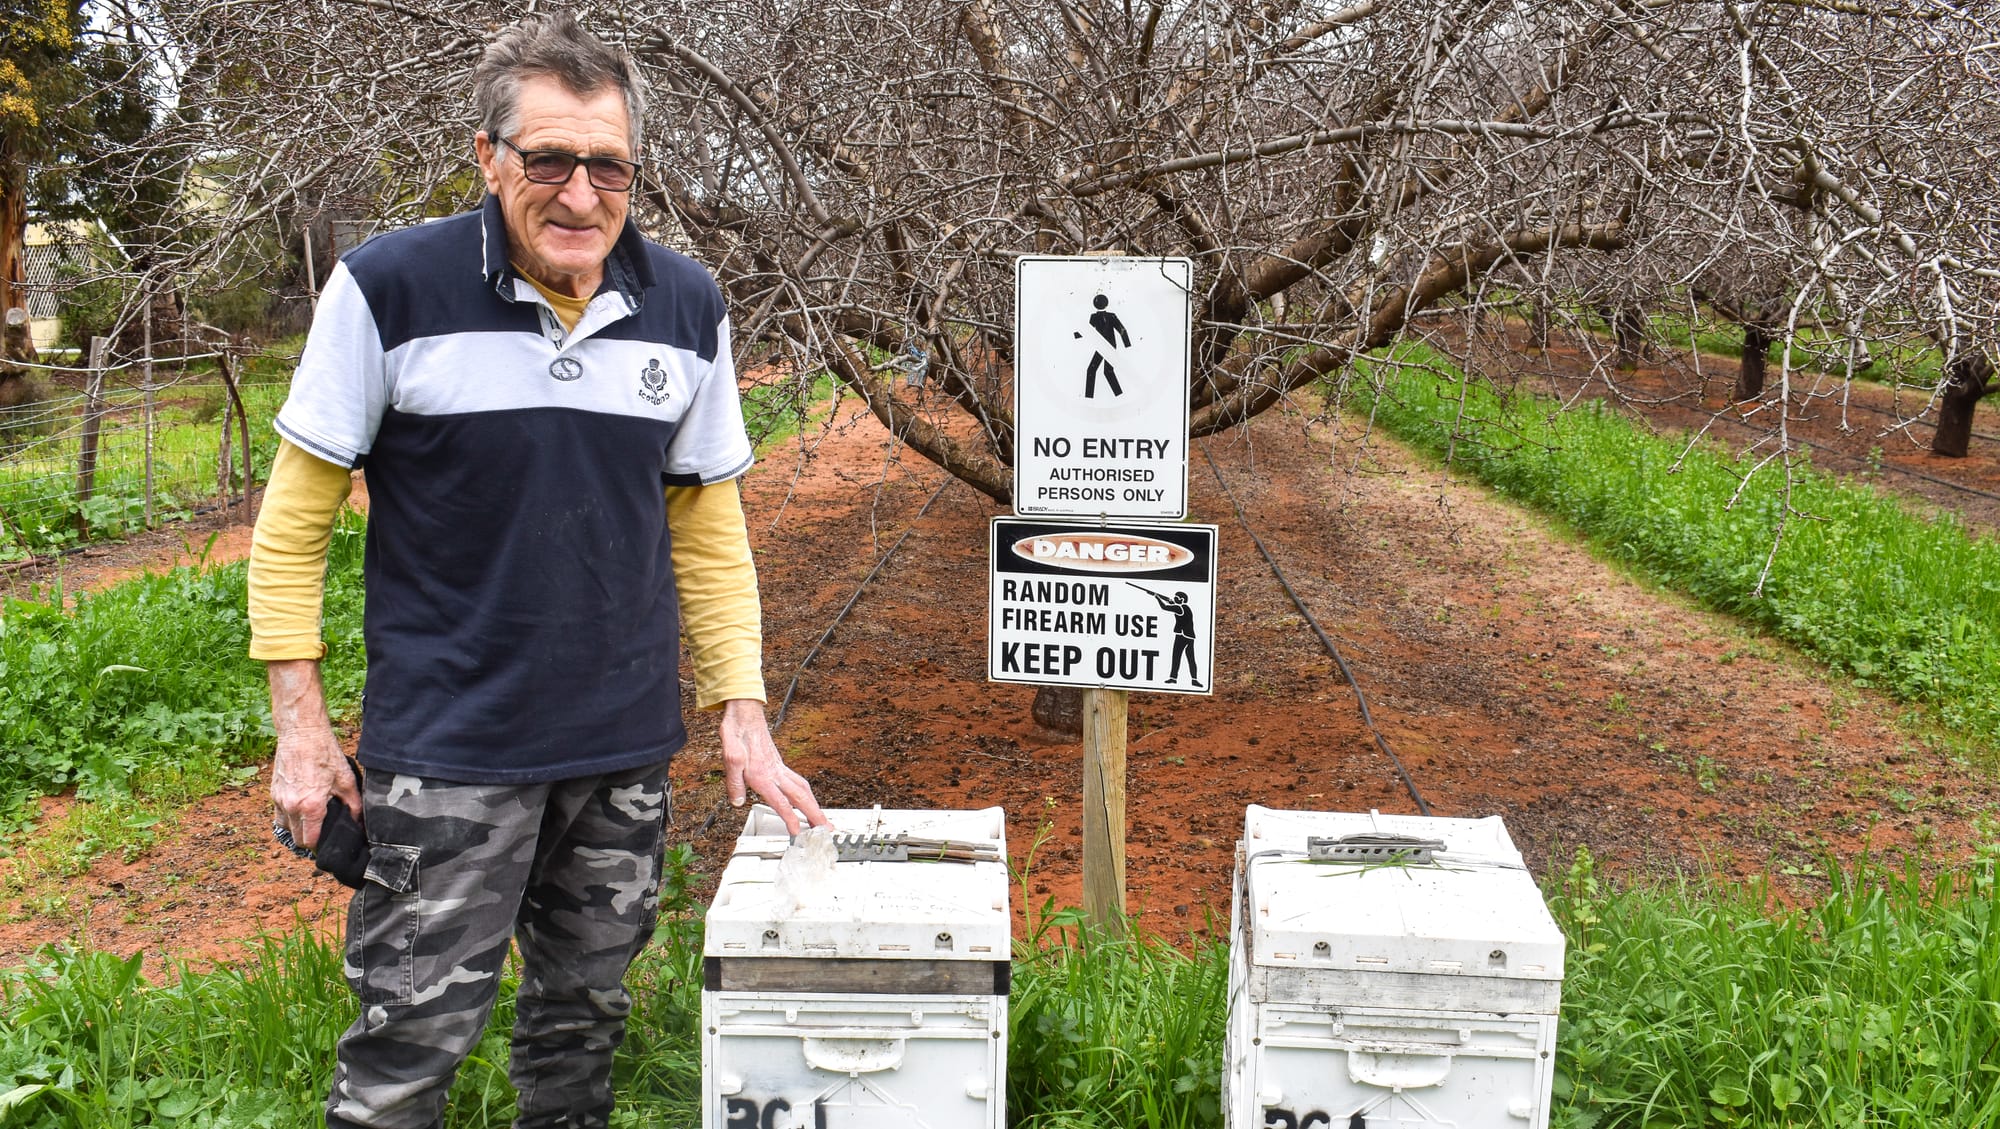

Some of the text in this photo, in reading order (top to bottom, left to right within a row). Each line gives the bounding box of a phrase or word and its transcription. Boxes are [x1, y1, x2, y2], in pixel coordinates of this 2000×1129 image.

[1034, 437, 1170, 460] NO ENTRY
[1049, 467, 1155, 482] AUTHORISED
[1038, 486, 1165, 502] PERSONS ONLY
[1033, 540, 1170, 563] DANGER
[1003, 579, 1109, 606] RANDOM
[1002, 607, 1158, 638] FIREARM USE
[1001, 641, 1160, 681] KEEP OUT
